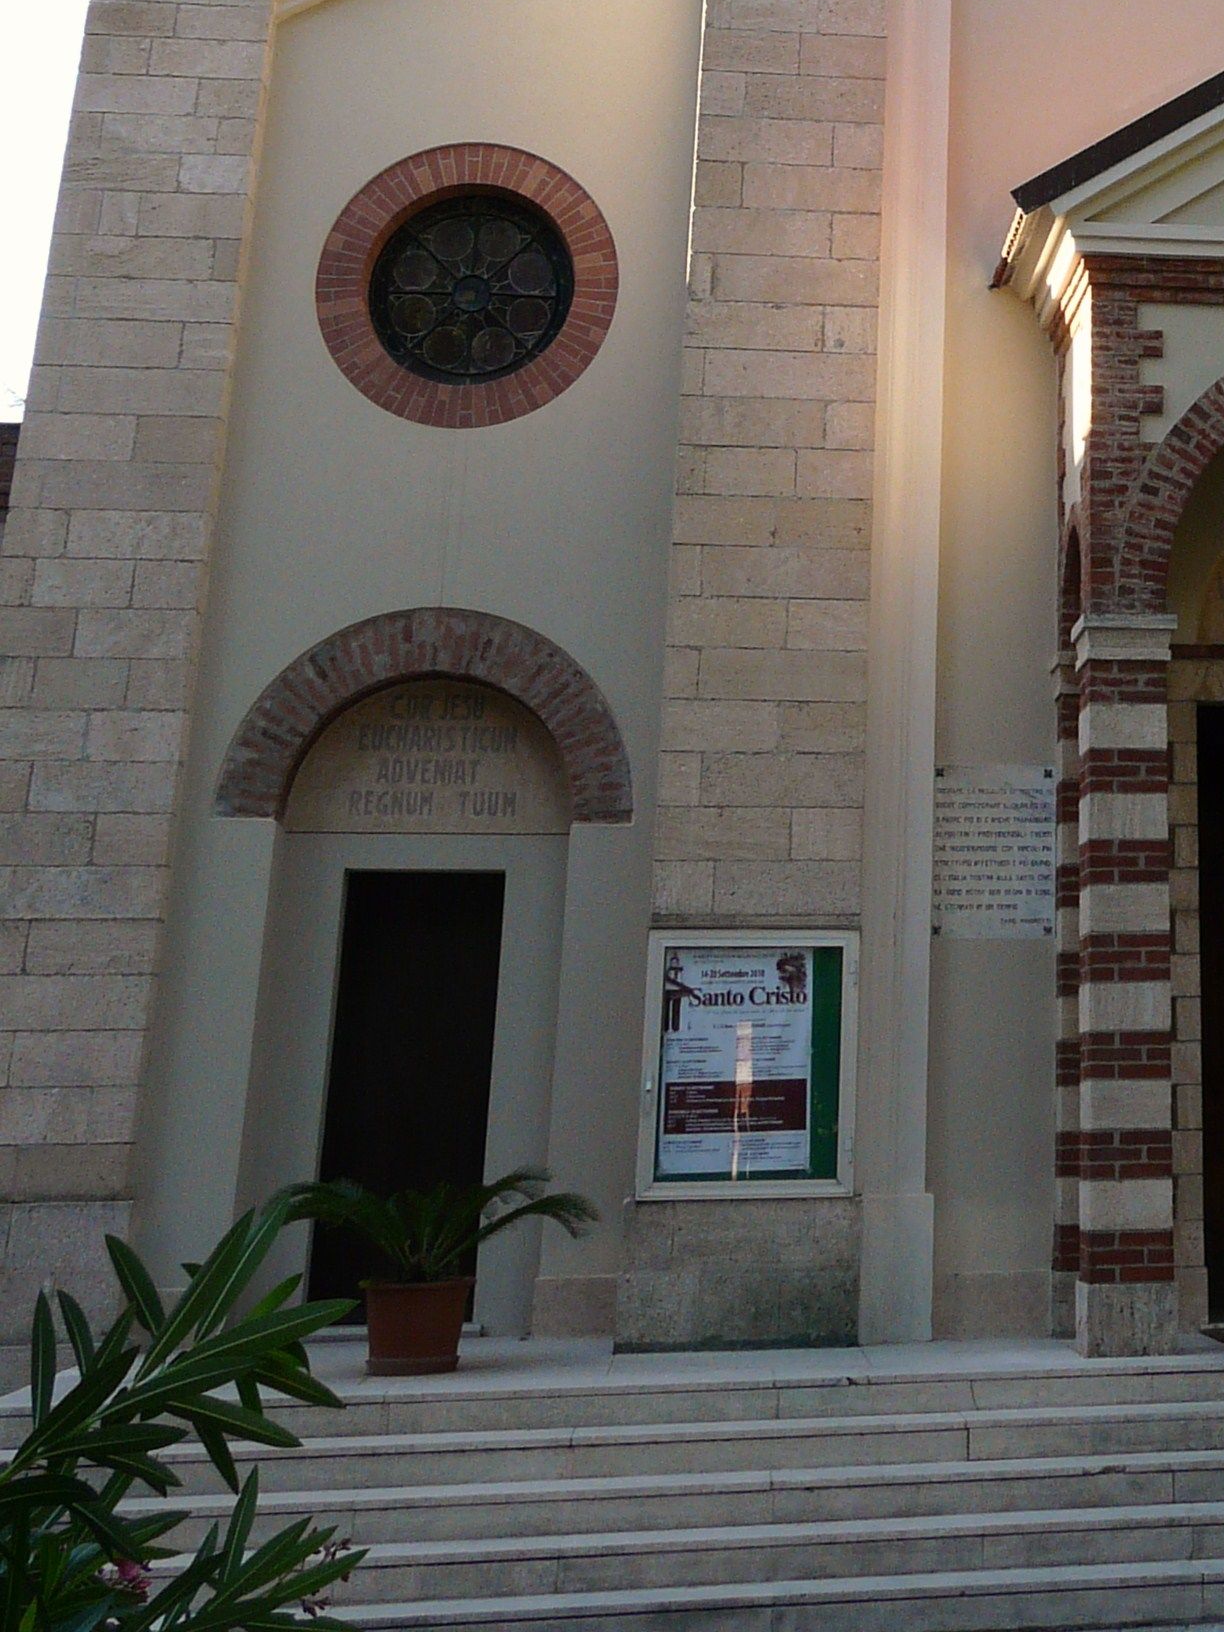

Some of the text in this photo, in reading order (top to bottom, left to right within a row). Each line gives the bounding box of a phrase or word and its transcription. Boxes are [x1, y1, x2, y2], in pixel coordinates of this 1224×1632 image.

[439, 692, 485, 721] JESU
[357, 724, 518, 754] EUCHARISTICUM
[376, 757, 481, 786] ADVENIAT
[347, 789, 518, 817] REGNUM TUUM
[688, 985, 807, 1007] Santo Cristo
